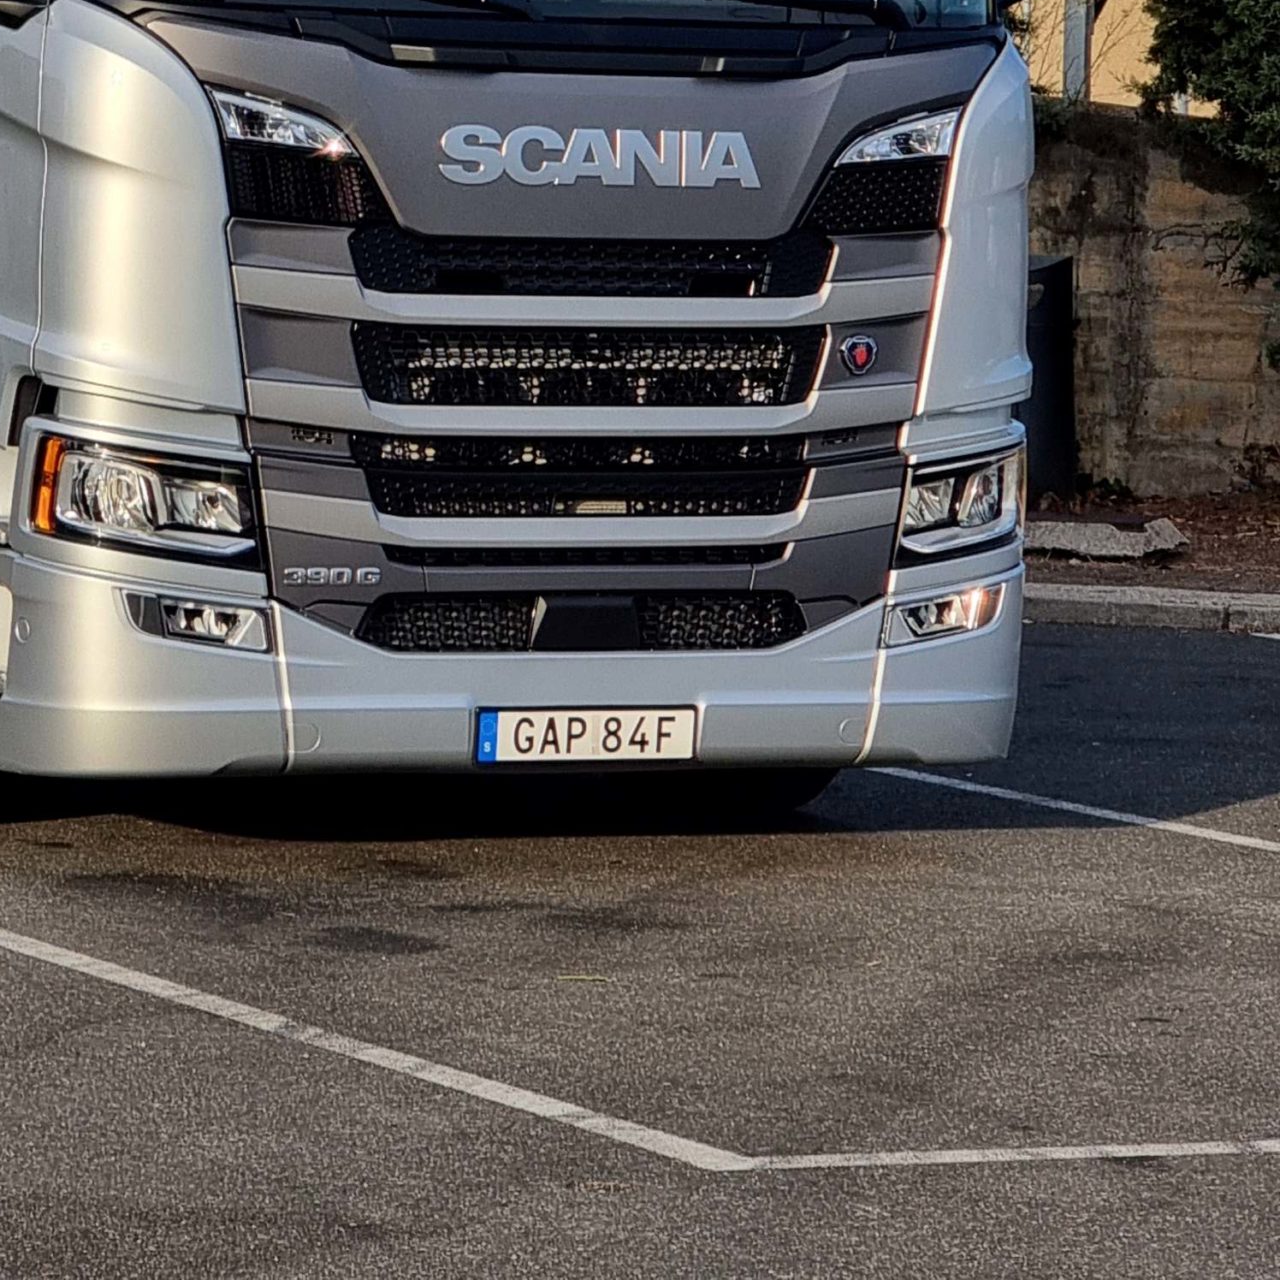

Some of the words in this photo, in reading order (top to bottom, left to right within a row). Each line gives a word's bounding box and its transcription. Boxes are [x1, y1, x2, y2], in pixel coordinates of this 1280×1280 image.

[438, 124, 761, 189] SCANIA
[513, 716, 587, 754] GAP
[601, 716, 676, 754] 84F
